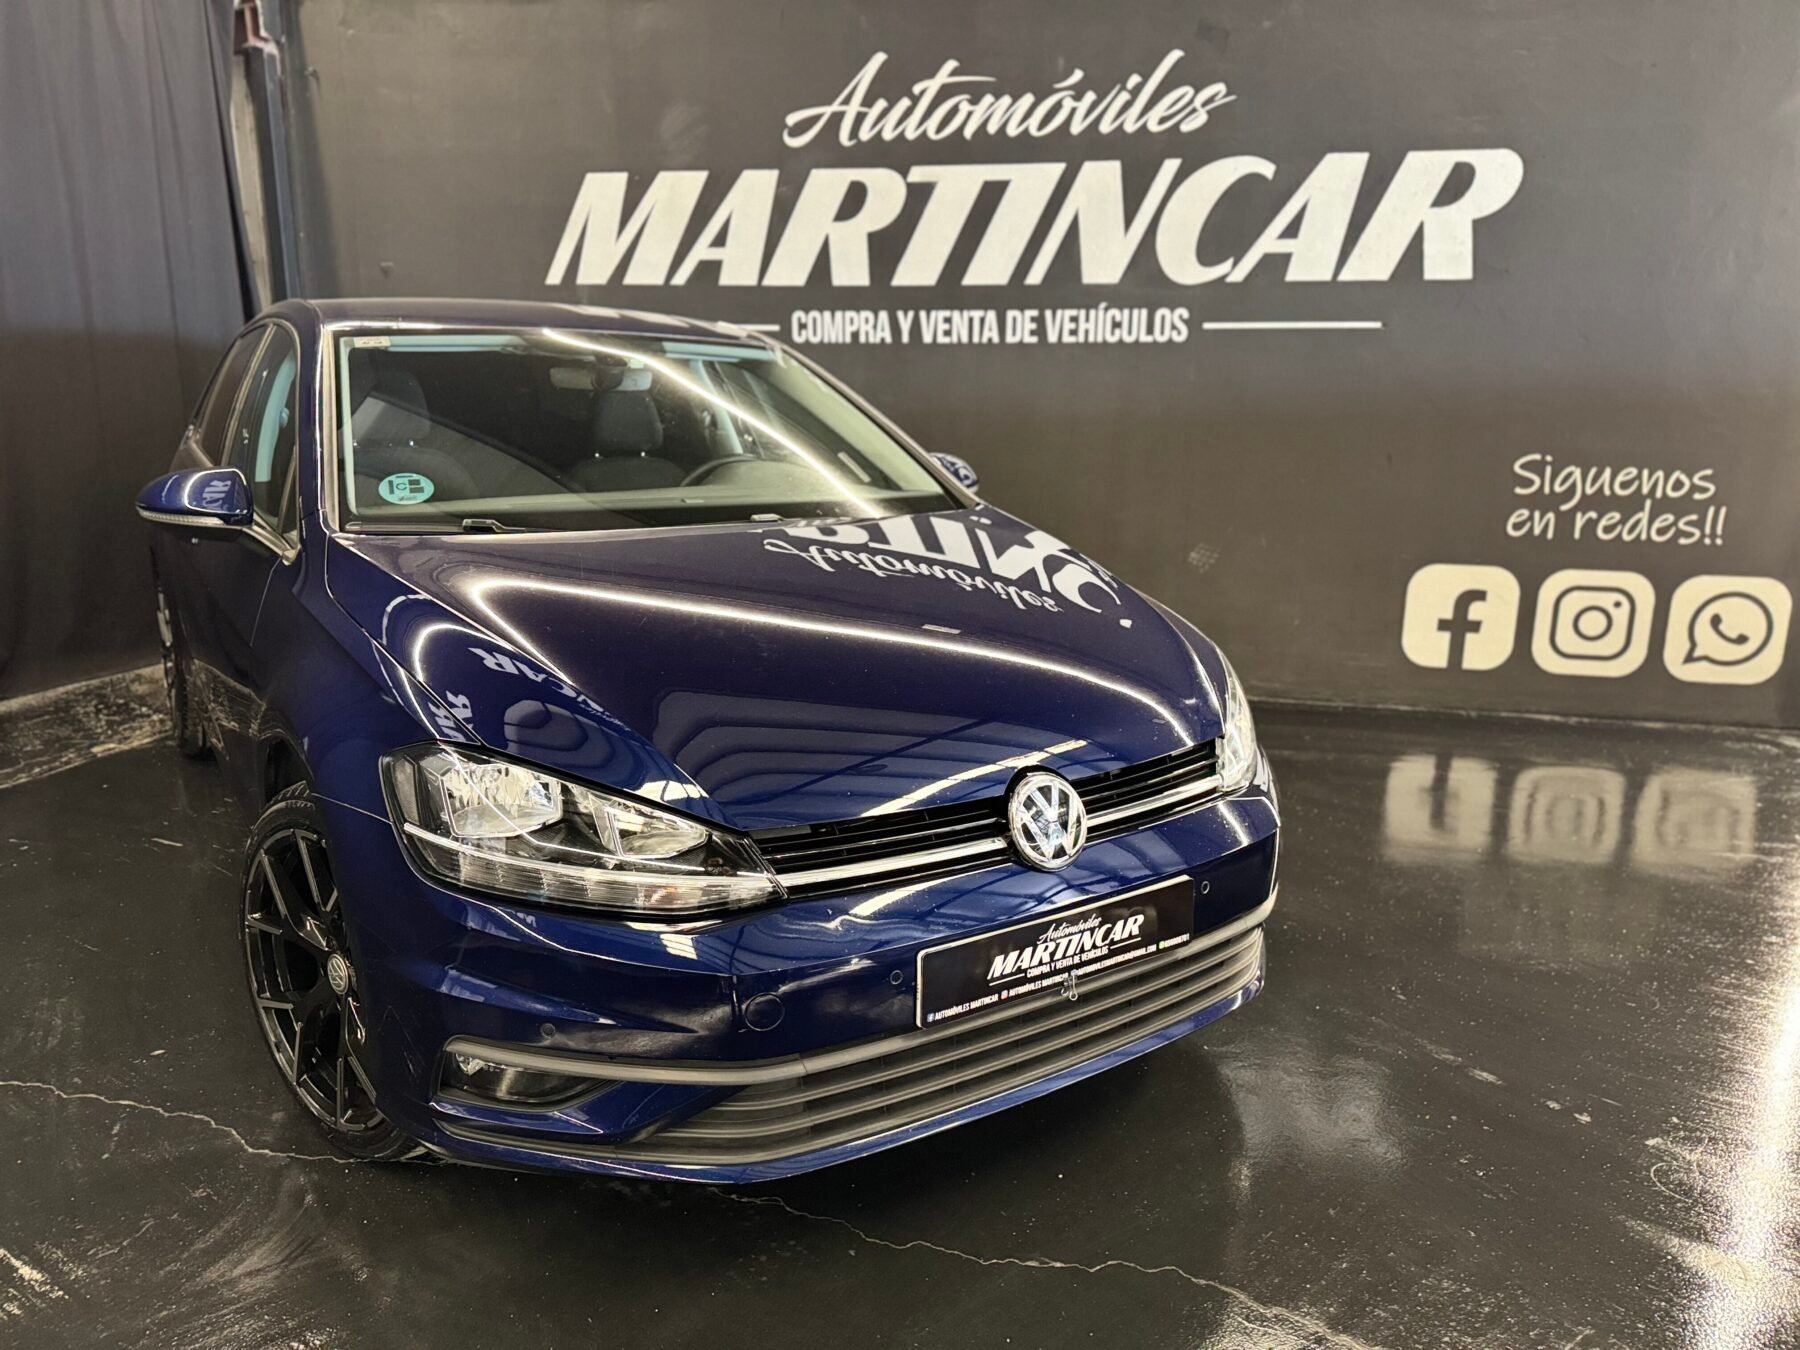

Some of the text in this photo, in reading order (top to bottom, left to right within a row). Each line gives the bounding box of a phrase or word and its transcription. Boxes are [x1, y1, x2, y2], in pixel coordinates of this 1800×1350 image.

[783, 49, 1237, 147] Automóviles
[545, 148, 1524, 286] MARTINCAR
[791, 302, 1189, 343] COMPRA Y VENTA DE VEHÍCULOS
[1506, 499, 1727, 546] en redes!!
[987, 914, 1144, 980] MARTINCAR
[1037, 914, 1102, 945] Automóviles
[1027, 962, 1050, 978] COMPRA
[1056, 957, 1073, 969] VENTA
